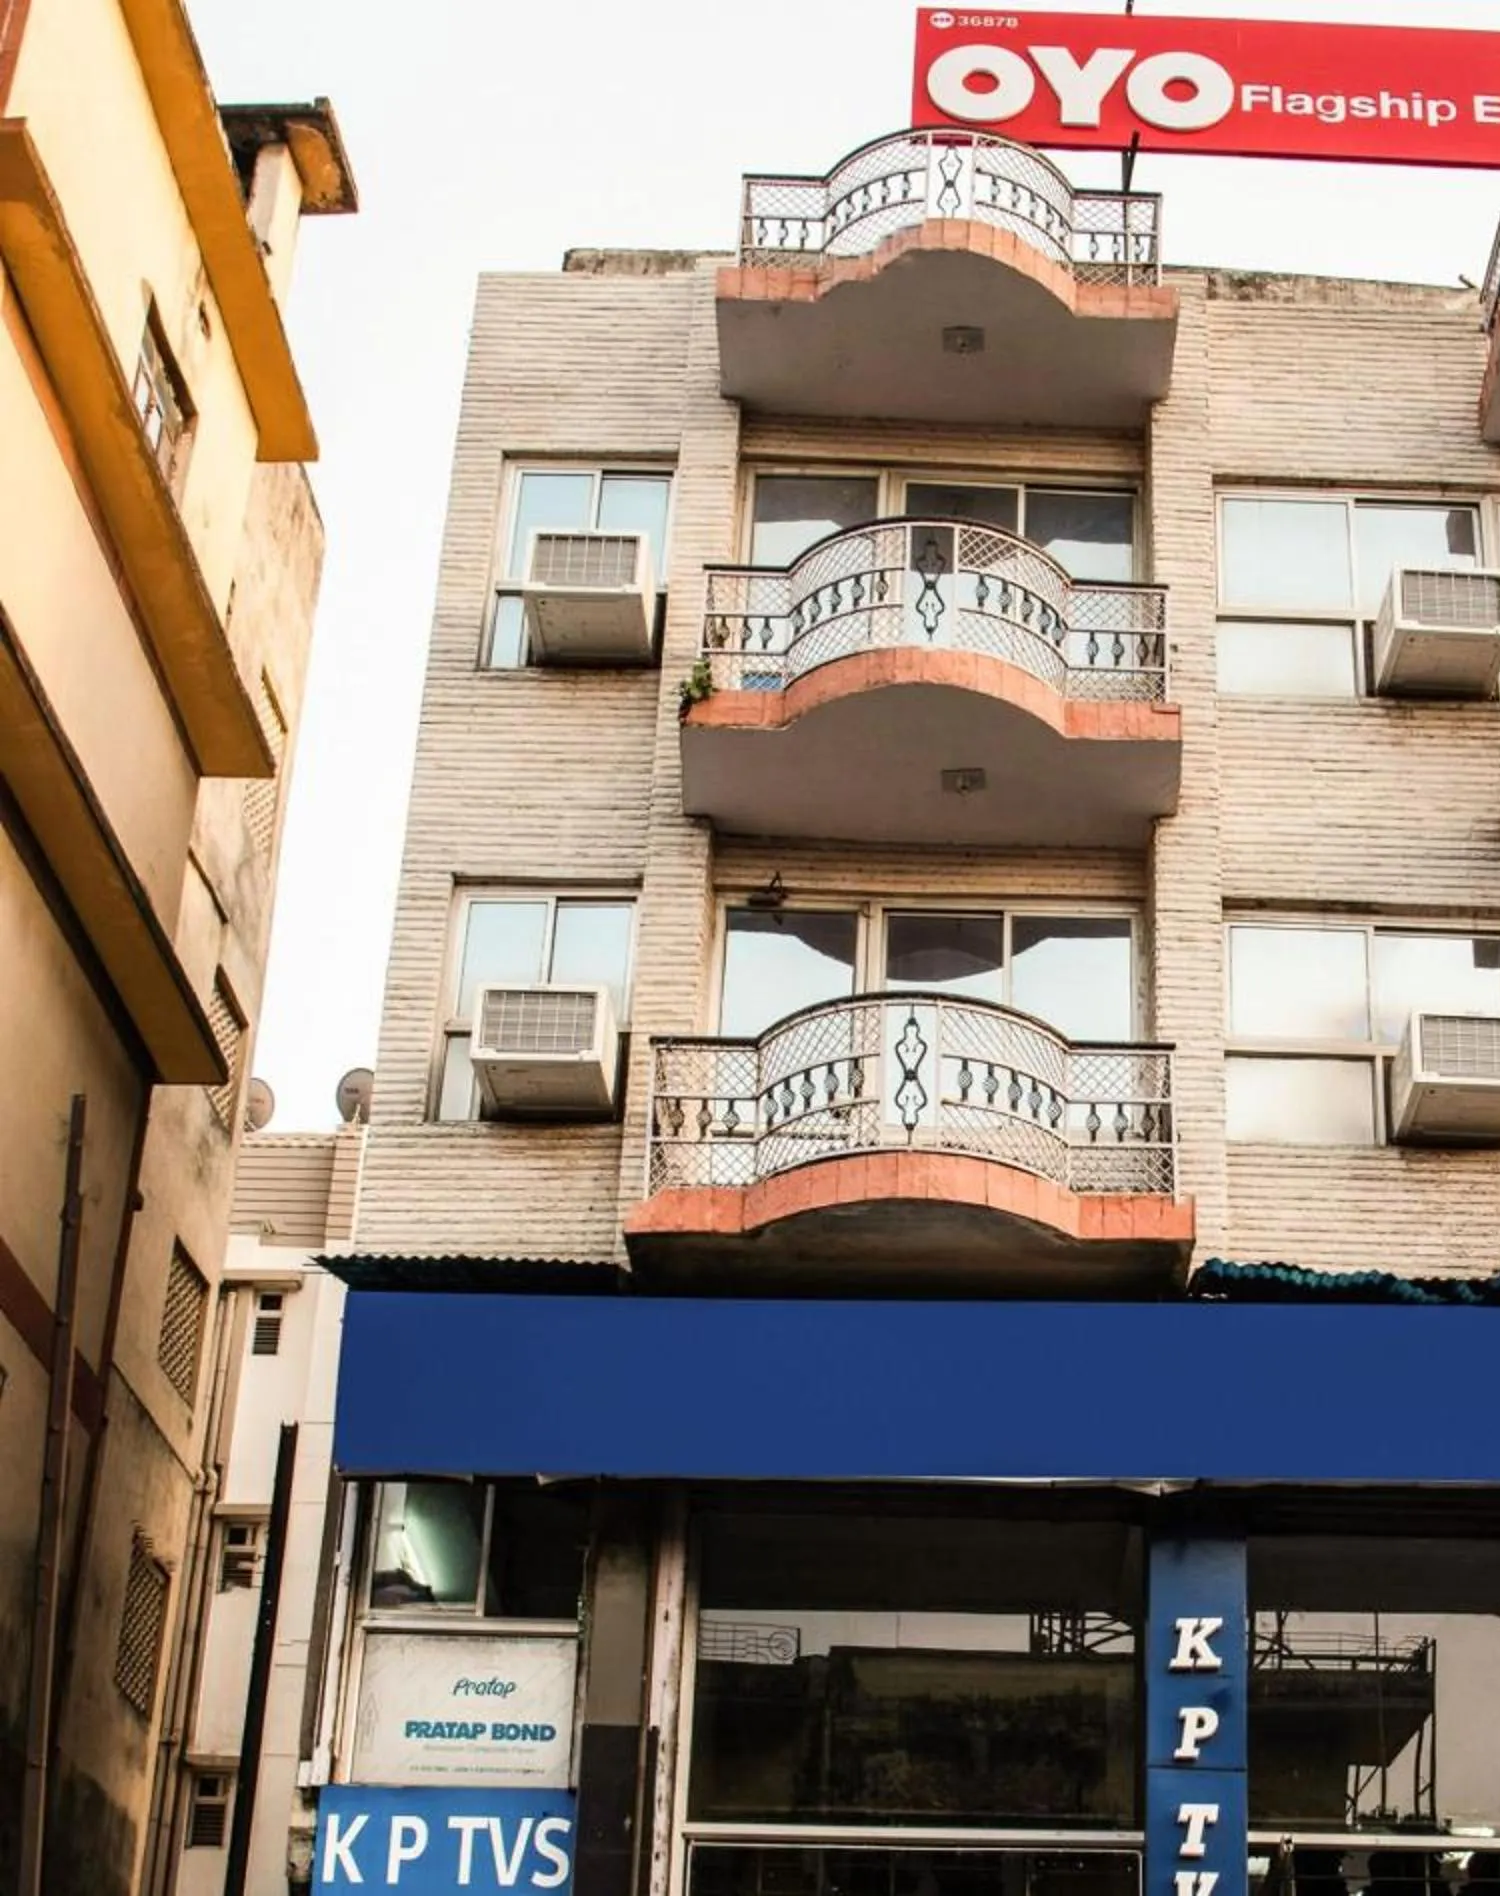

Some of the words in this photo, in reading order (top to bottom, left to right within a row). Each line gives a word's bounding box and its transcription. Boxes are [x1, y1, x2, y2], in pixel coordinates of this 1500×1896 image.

[925, 43, 1236, 129] OYO
[1240, 84, 1458, 127] Flagship
[453, 1677, 517, 1698] Pratap
[404, 1720, 487, 1739] PRATAP
[491, 1723, 557, 1742] BOND
[321, 1813, 370, 1884] K
[386, 1815, 429, 1886] P
[447, 1815, 573, 1889] TVS
